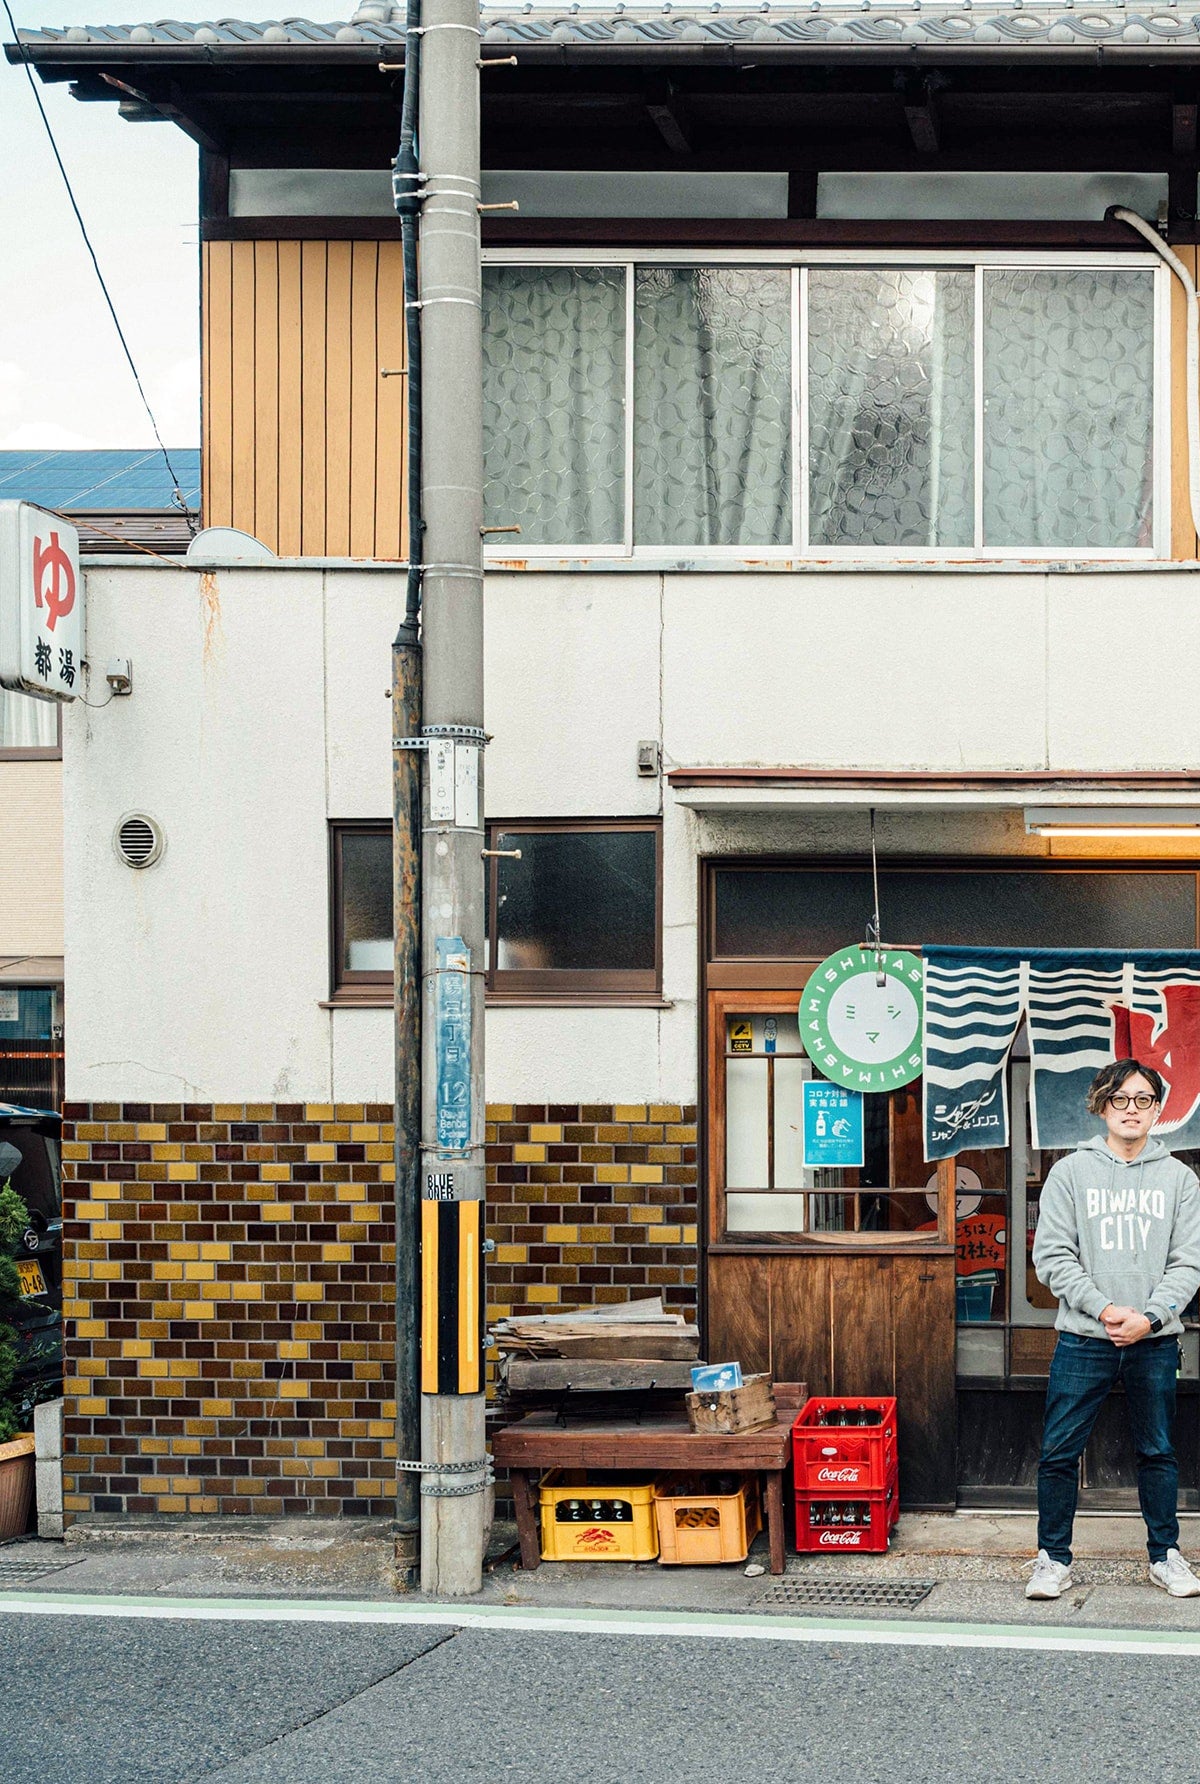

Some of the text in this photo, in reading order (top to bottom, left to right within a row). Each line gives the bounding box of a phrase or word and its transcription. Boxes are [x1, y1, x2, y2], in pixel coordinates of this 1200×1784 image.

[33, 532, 76, 632] ゆ
[35, 636, 76, 688] 都湯
[442, 1081, 467, 1105] 12
[427, 1174, 454, 1186] BLUE
[1086, 1188, 1165, 1220] BIWAKO
[1100, 1214, 1152, 1251] CITY
[817, 1467, 860, 1482] Coca-Cola
[819, 1530, 862, 1545] Coca-Cola
